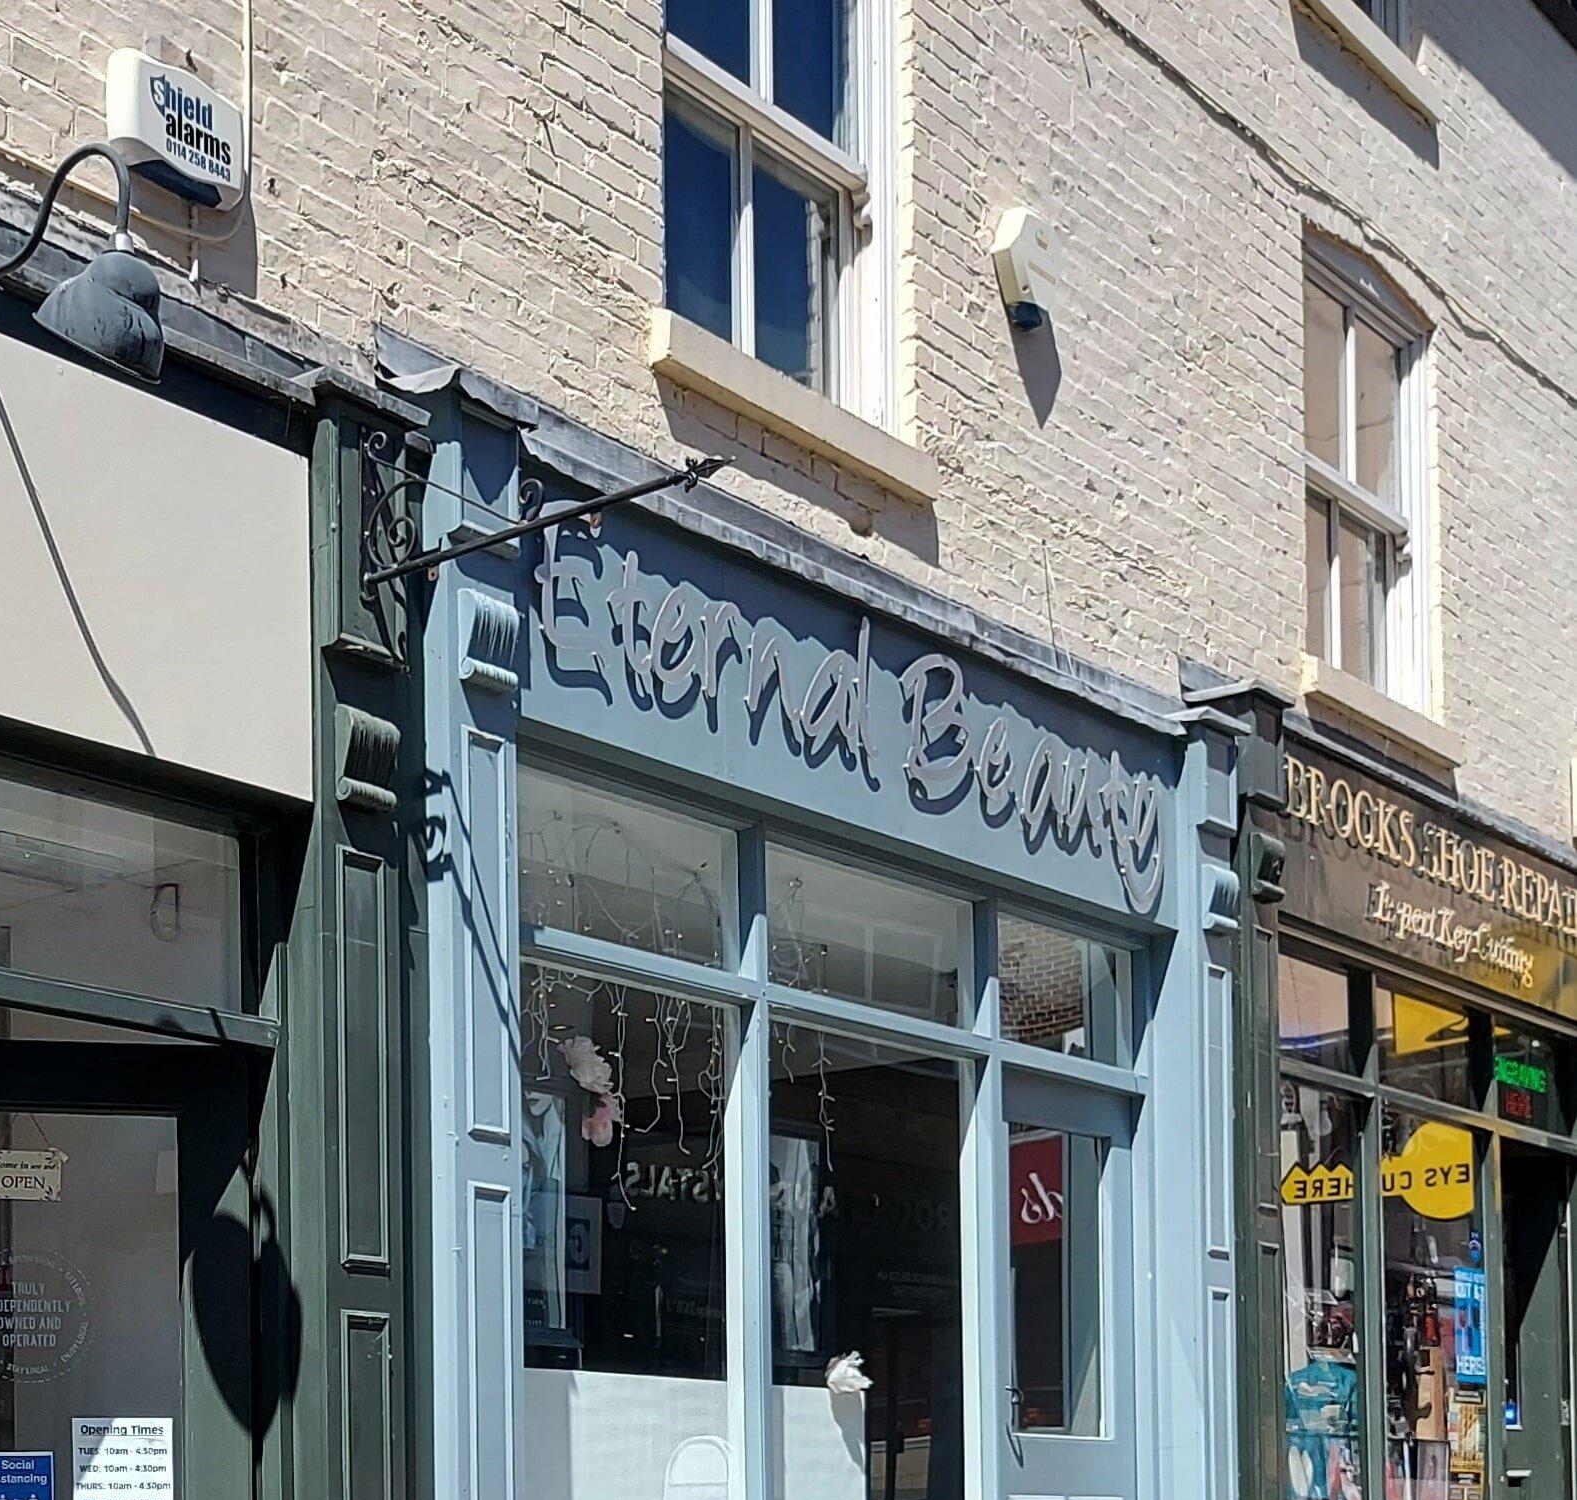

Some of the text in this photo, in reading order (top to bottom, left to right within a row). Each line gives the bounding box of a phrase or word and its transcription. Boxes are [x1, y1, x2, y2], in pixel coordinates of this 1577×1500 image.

[151, 79, 213, 131] Shield
[166, 113, 231, 165] alarms
[166, 137, 187, 161] 0114
[189, 151, 206, 170] 258
[535, 500, 1164, 906] Eternal Beauty
[1284, 755, 1416, 868] BROOKS
[1436, 906, 1471, 962] Key
[2, 1175, 45, 1189] OPEN
[12, 1282, 45, 1296] TRULY
[39, 1317, 61, 1330] AND
[2, 1334, 57, 1347] OPERATED
[80, 1425, 164, 1437] Opening Times
[1, 1459, 35, 1470] Social
